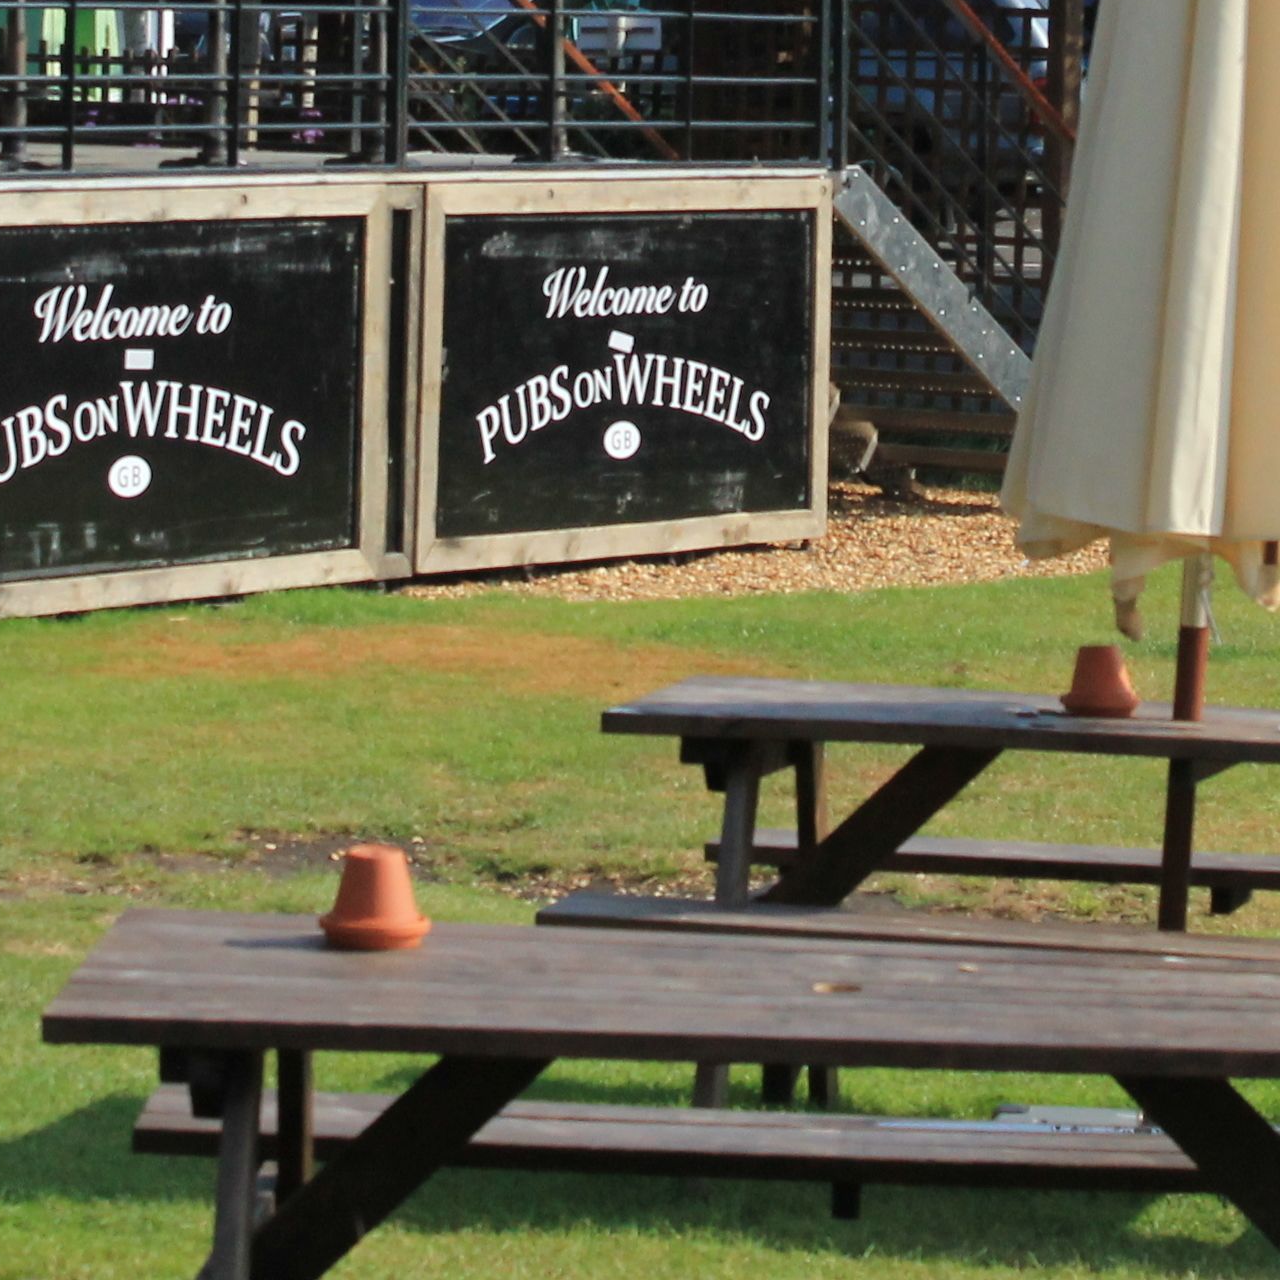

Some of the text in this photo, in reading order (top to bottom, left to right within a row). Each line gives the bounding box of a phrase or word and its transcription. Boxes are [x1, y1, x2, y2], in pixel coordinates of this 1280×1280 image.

[34, 283, 233, 343] Welcome to
[542, 266, 709, 319] Welcome to
[73, 394, 120, 442] ON
[120, 380, 306, 477] WHEELS
[475, 353, 771, 465] PUBS ON WHEELS
[610, 429, 633, 452] GB
[116, 465, 142, 489] GB
